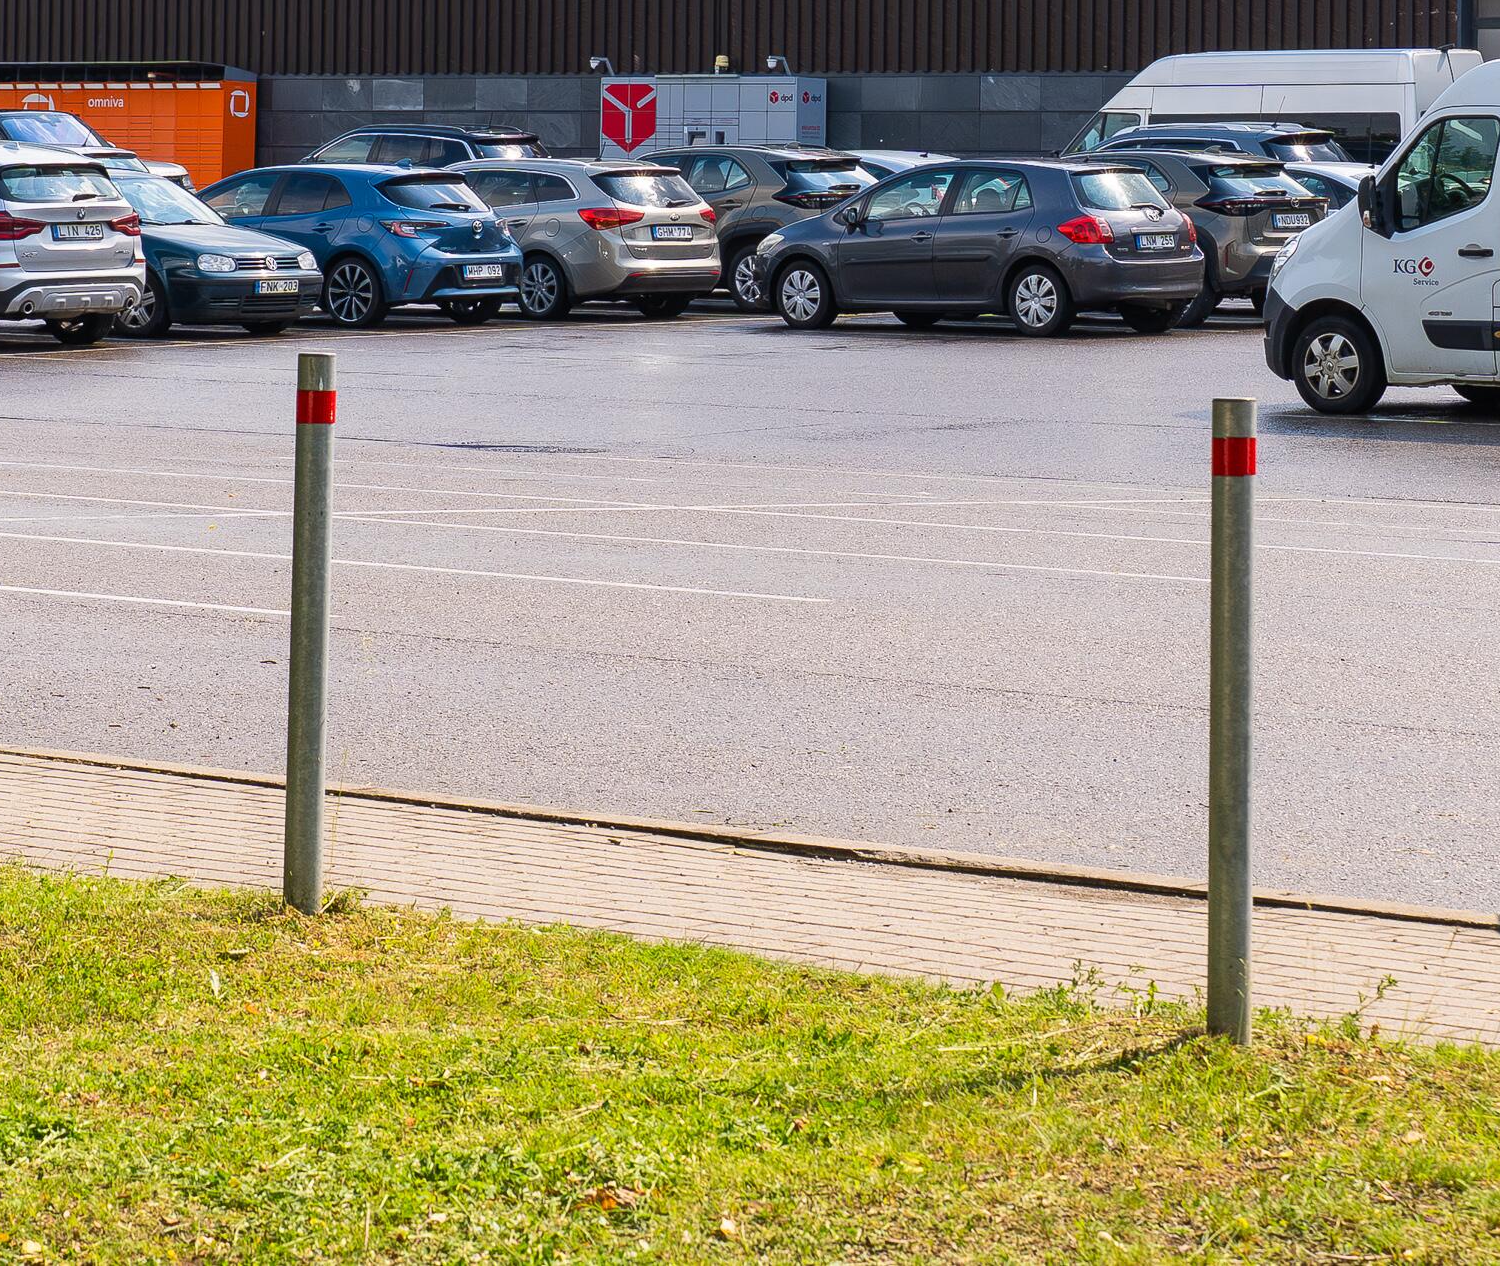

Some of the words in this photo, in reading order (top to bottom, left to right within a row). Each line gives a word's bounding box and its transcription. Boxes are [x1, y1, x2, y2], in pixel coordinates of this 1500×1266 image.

[87, 96, 125, 109] omniva
[780, 93, 794, 103] dpd
[810, 94, 822, 103] dpd
[59, 225, 80, 237] LIN
[84, 225, 101, 236] 425
[1141, 235, 1157, 247] LNM
[1160, 235, 1174, 246] 255
[487, 265, 501, 275] 092
[260, 281, 279, 292] FNK
[283, 281, 298, 292] 203
[1412, 277, 1440, 286] Service
